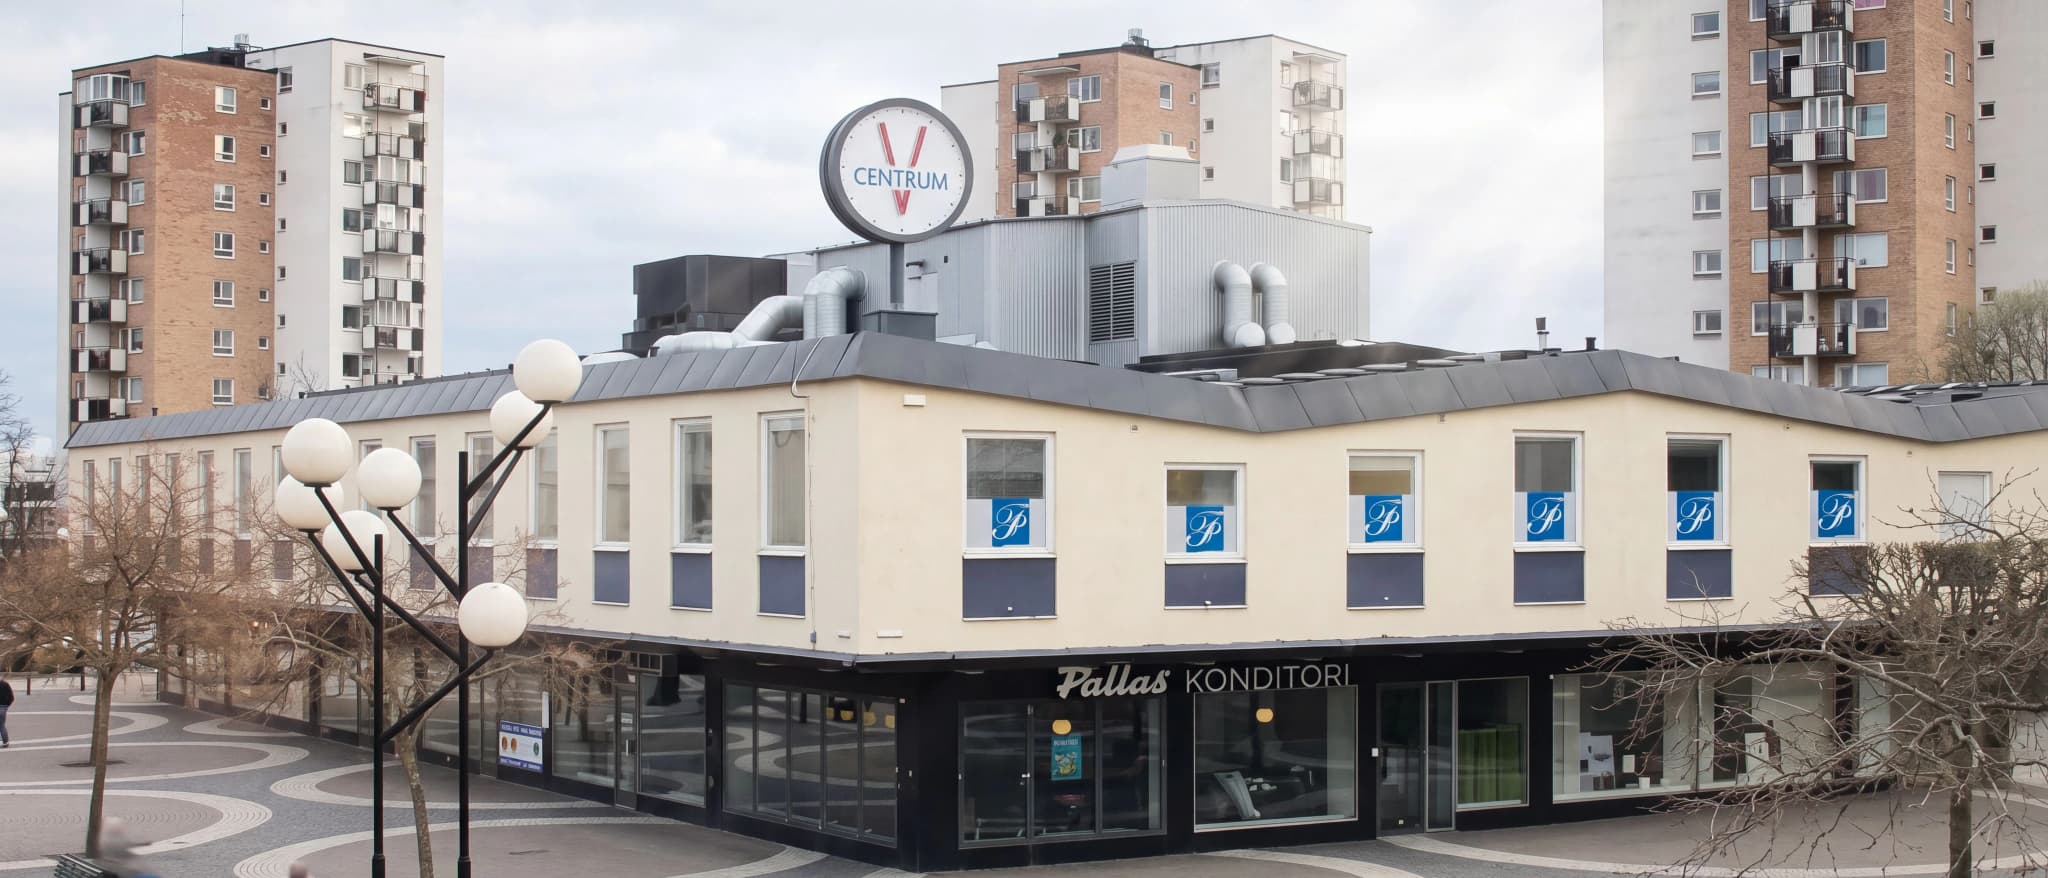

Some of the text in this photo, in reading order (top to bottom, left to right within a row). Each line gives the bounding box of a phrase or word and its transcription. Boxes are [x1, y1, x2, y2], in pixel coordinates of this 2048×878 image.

[854, 167, 948, 190] CENTRUM
[879, 122, 927, 215] V
[1056, 663, 1349, 699] Pallas KONDITORI
